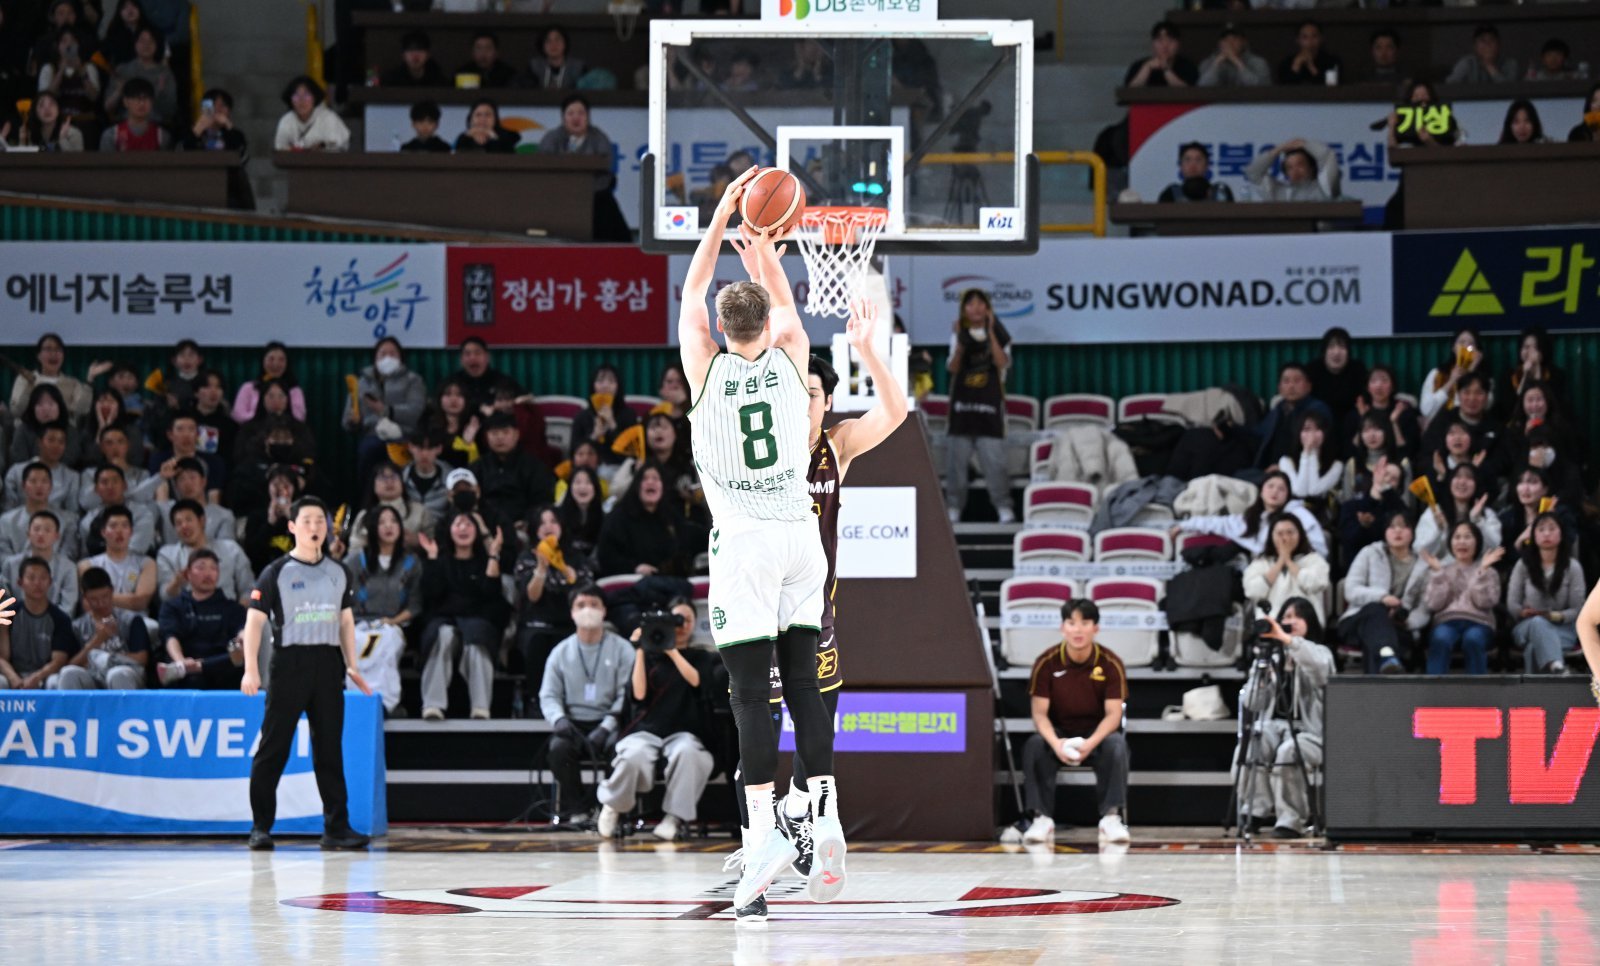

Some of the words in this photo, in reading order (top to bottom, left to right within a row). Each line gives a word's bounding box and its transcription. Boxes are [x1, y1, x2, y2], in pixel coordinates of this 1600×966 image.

[1395, 105, 1451, 134] 기상
[6, 273, 233, 315] 에너지솔루션
[502, 278, 587, 312] 정심가
[594, 278, 653, 312] 홍삼
[1046, 277, 1361, 310] SUNGWONAD.COM
[738, 401, 779, 470] 8
[839, 525, 909, 539] GE.COM
[841, 712, 957, 734] #직관챌린지
